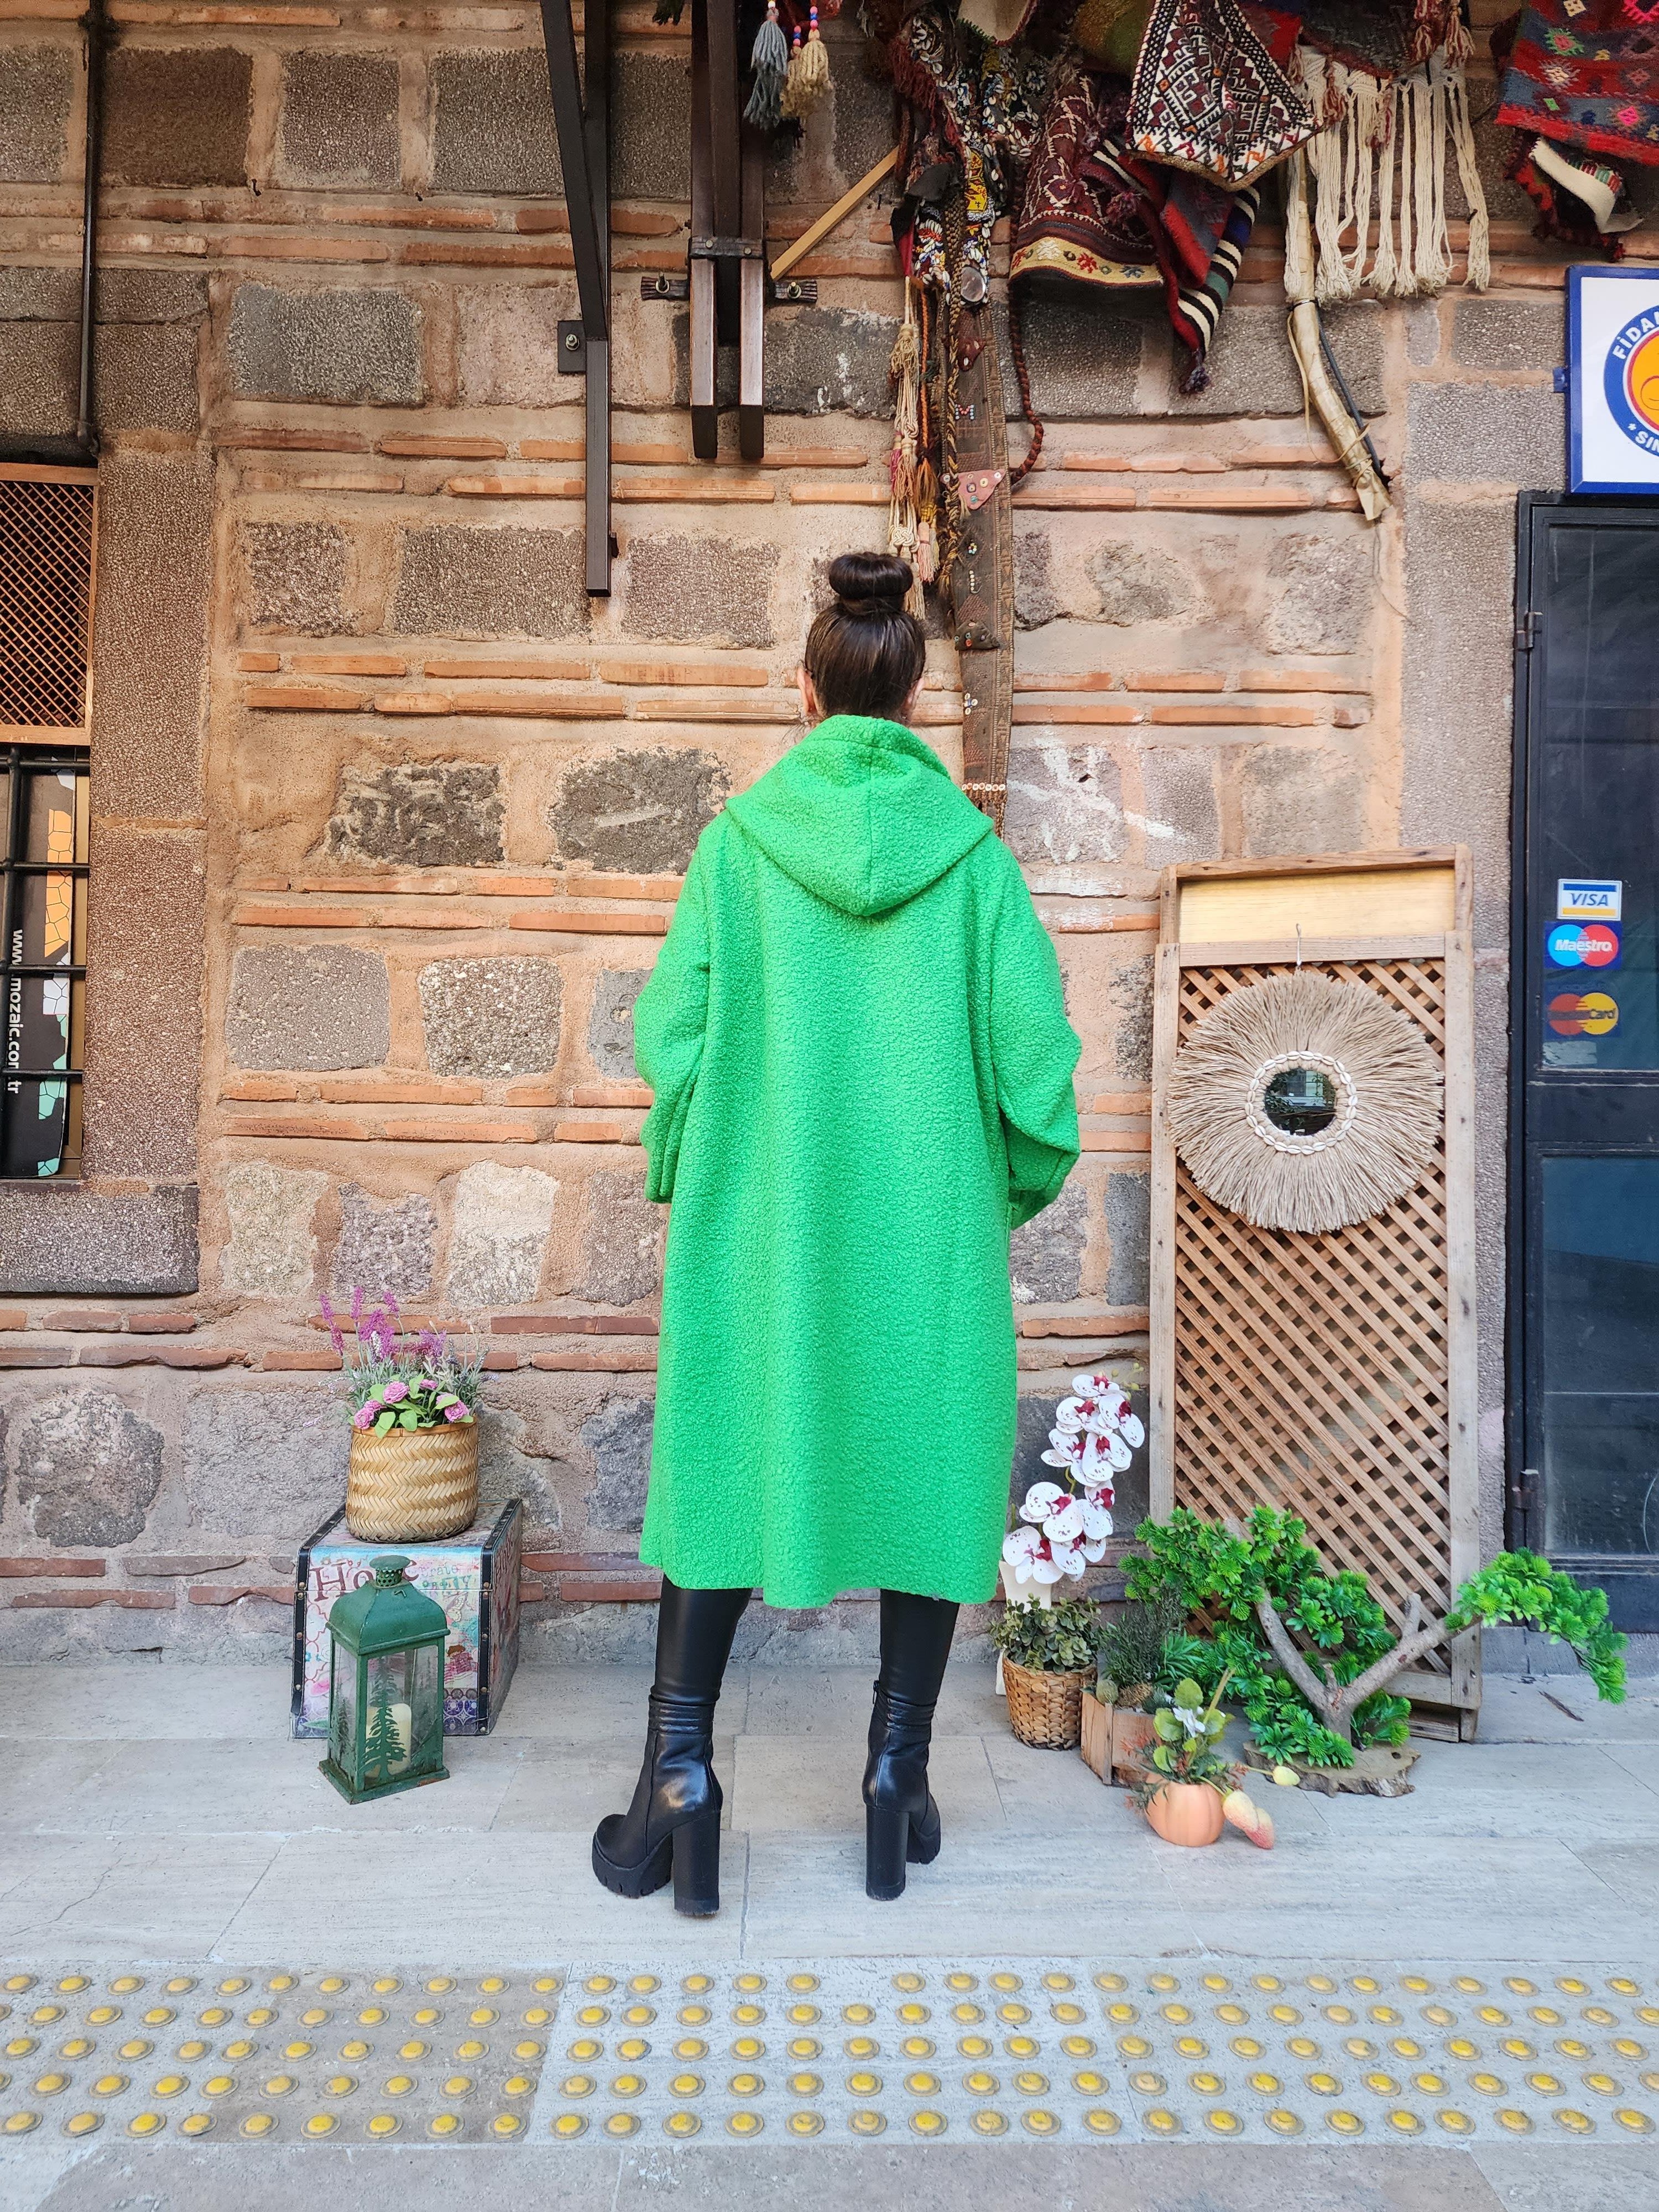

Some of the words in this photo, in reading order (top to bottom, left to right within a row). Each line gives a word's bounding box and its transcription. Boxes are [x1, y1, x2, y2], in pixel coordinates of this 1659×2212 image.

[1571, 893, 1609, 906] VISA
[1555, 939, 1613, 952] Maestro
[310, 1559, 419, 1602] Hoe
